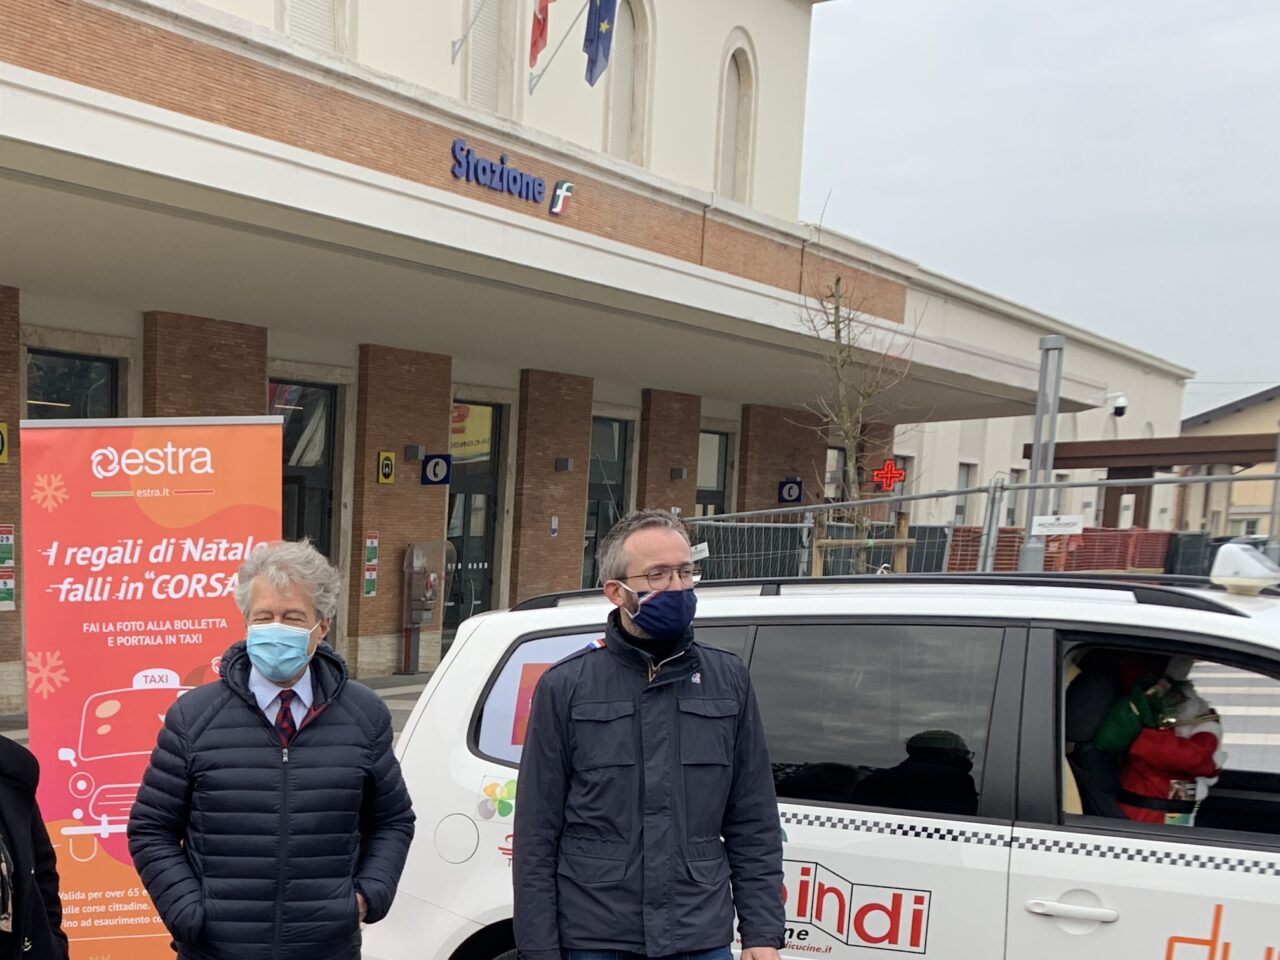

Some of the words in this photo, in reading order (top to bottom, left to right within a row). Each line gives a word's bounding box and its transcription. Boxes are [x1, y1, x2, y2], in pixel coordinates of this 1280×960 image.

[451, 139, 546, 203] Stazione
[121, 442, 214, 475] estra
[137, 487, 169, 497] estra.it
[42, 541, 59, 566] I
[64, 539, 143, 572] regali
[149, 538, 176, 563] di
[54, 576, 111, 602] falli
[117, 576, 144, 600] in
[83, 623, 99, 633] FAI
[102, 622, 114, 632] LA
[117, 621, 145, 632] FOTO
[146, 620, 172, 631] ALLA
[174, 618, 228, 630] BOLLETTA
[108, 636, 114, 646] E
[117, 635, 163, 646] PORTALA
[165, 634, 176, 645] IN
[179, 634, 203, 644] TAXI
[143, 674, 168, 684] TAXI
[88, 892, 103, 901] per
[105, 890, 125, 898] over
[127, 888, 139, 897] 65
[62, 906, 80, 914] ulle
[82, 905, 105, 913] corse
[108, 902, 151, 911] cittadine.
[782, 867, 926, 948] indi
[80, 918, 91, 927] ad
[94, 916, 150, 926] esaurimento
